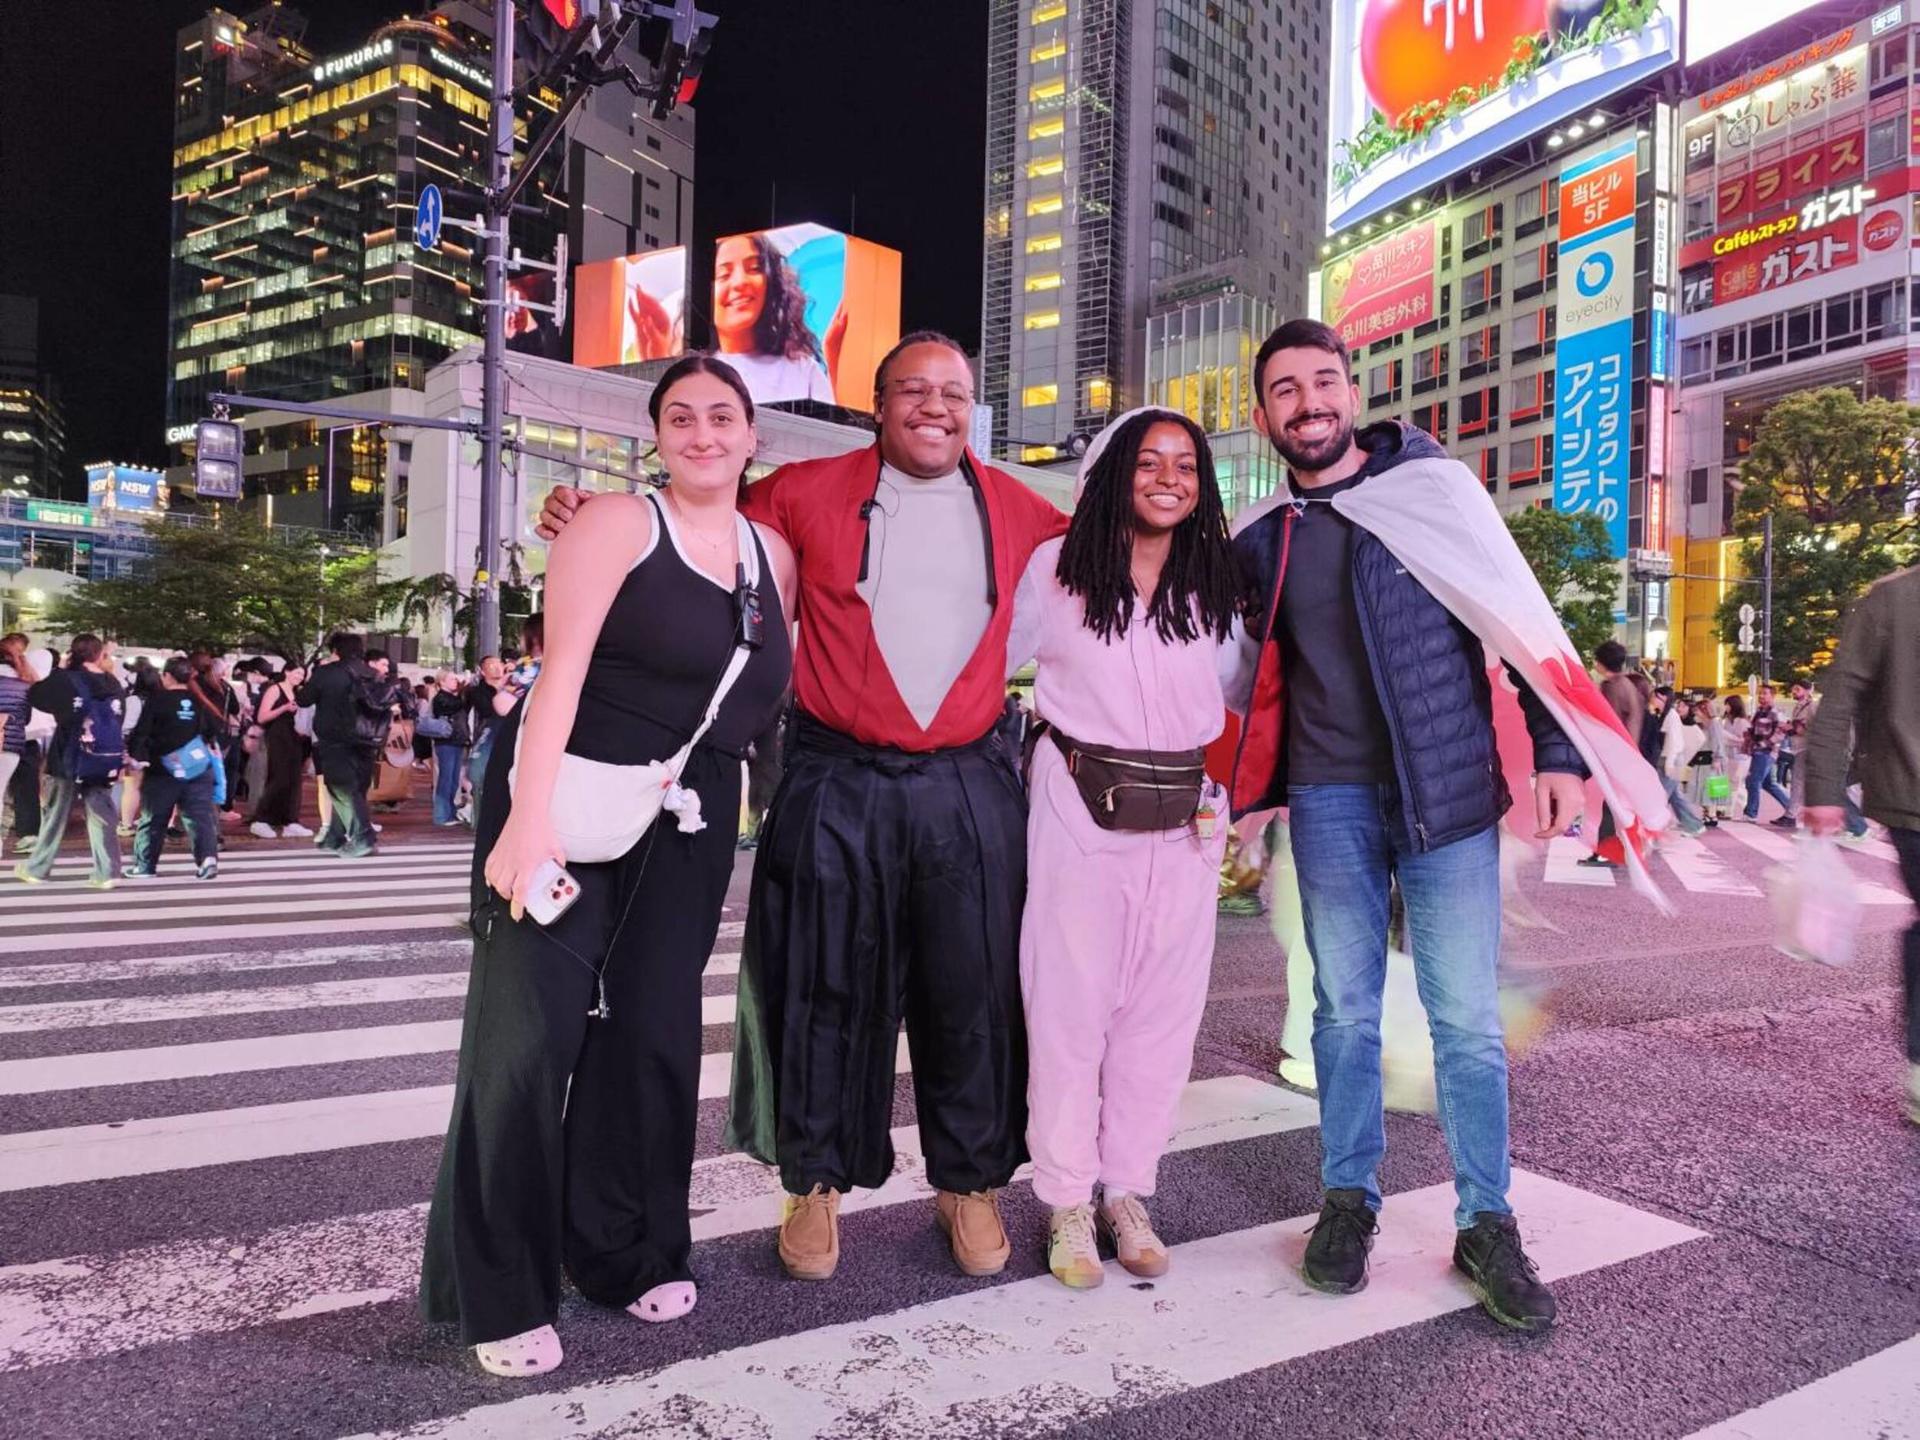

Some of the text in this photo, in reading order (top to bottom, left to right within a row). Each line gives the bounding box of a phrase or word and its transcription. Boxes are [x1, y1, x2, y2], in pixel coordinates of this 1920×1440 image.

[1766, 67, 1857, 126] しゃぶ葉
[1688, 132, 1713, 158] 9F
[1572, 171, 1622, 207] 当ビル
[1720, 138, 1861, 214] プライス
[1584, 197, 1610, 223] 5F
[1800, 184, 1877, 231] ガスト
[1761, 235, 1849, 289] ガスト
[1566, 294, 1624, 324] eyecity
[1685, 278, 1713, 304] 7F
[1595, 353, 1621, 522] コンタクトの
[120, 480, 151, 494] NSW
